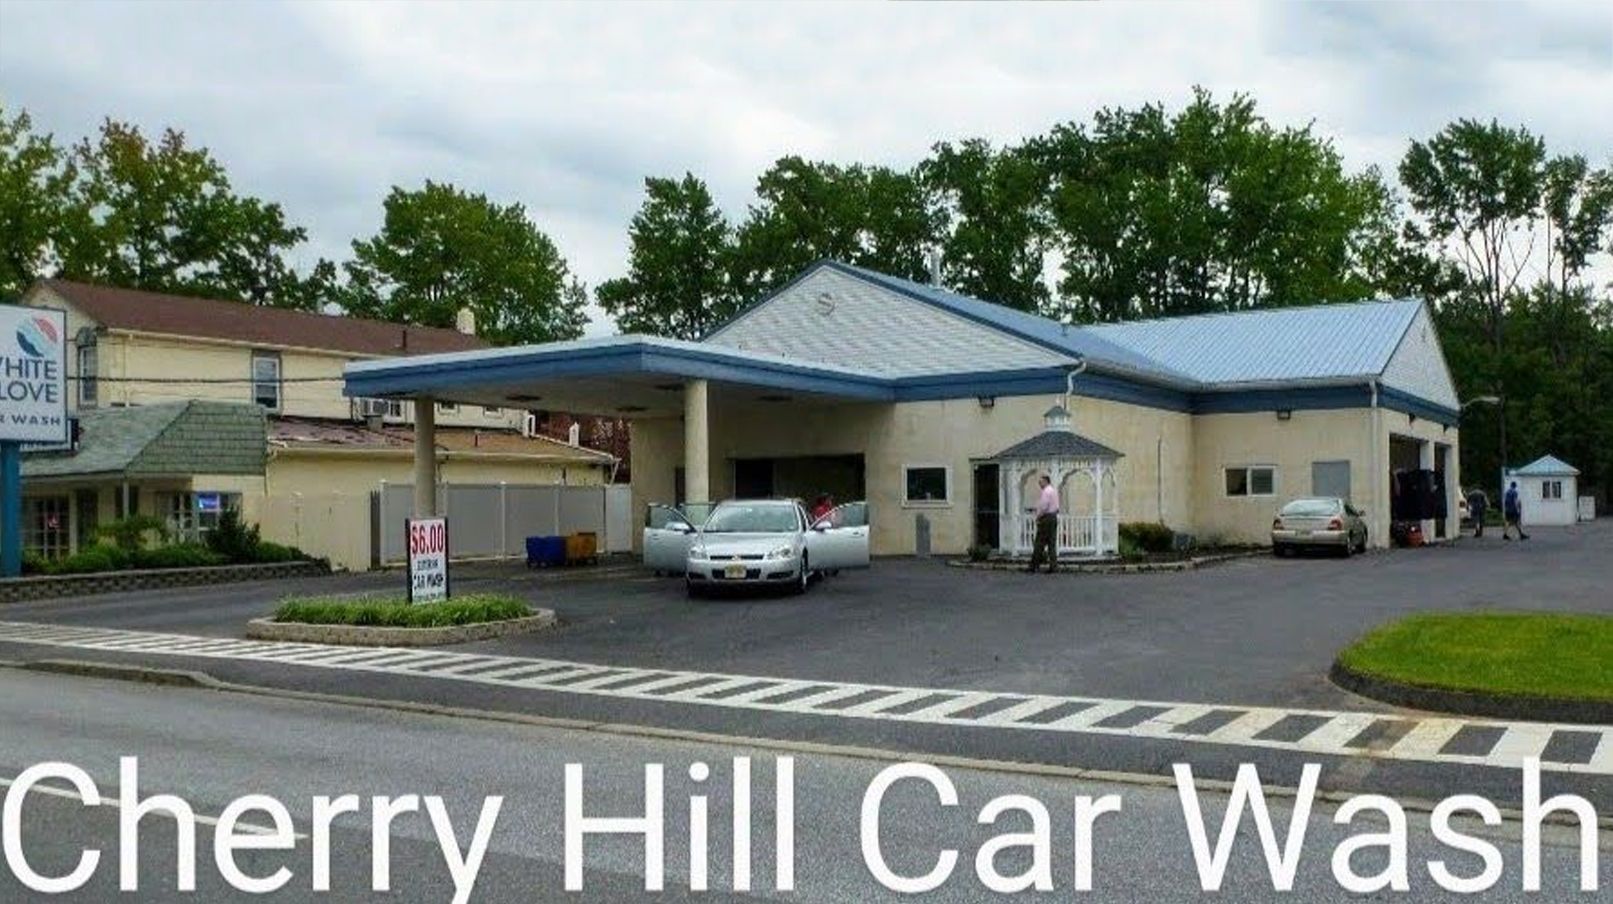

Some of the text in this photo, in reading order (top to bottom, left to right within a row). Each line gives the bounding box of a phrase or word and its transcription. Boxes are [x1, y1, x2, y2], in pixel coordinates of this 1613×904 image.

[0, 357, 57, 380] HITE
[12, 415, 61, 425] WASH
[412, 523, 444, 558] $6.00
